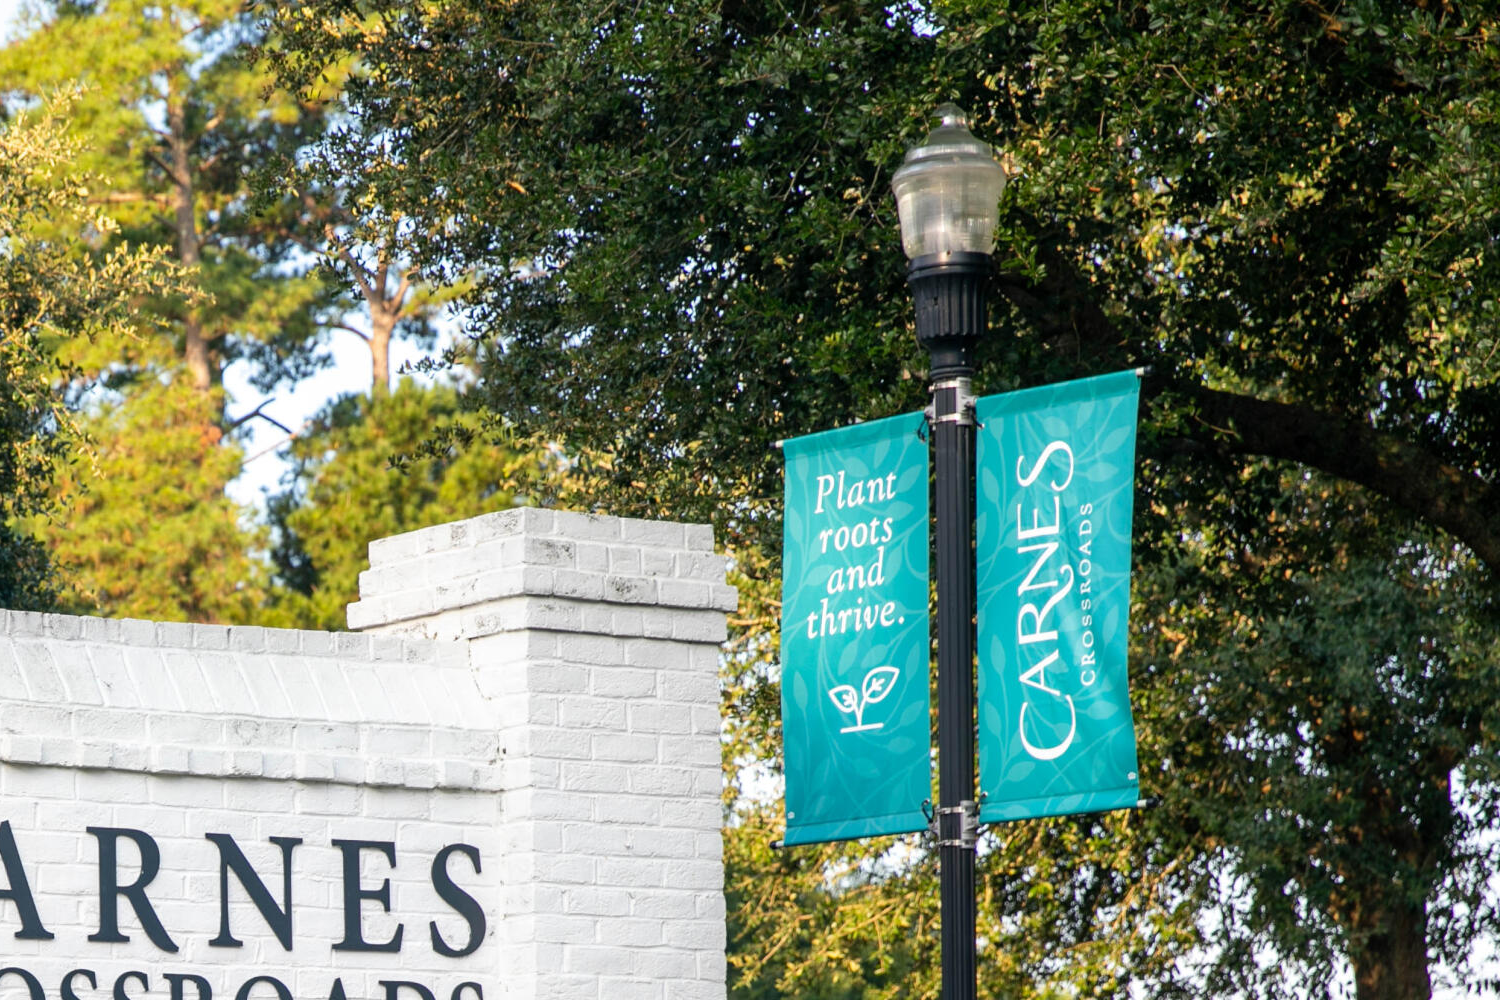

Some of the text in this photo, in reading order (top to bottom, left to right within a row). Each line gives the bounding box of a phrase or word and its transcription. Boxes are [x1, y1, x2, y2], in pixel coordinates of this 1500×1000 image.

[813, 469, 897, 515] Plant
[817, 515, 893, 555] roots
[826, 545, 885, 595] and
[806, 596, 905, 640] thrive.
[1016, 440, 1075, 761] CARNES
[1079, 502, 1096, 687] CROSSROADS
